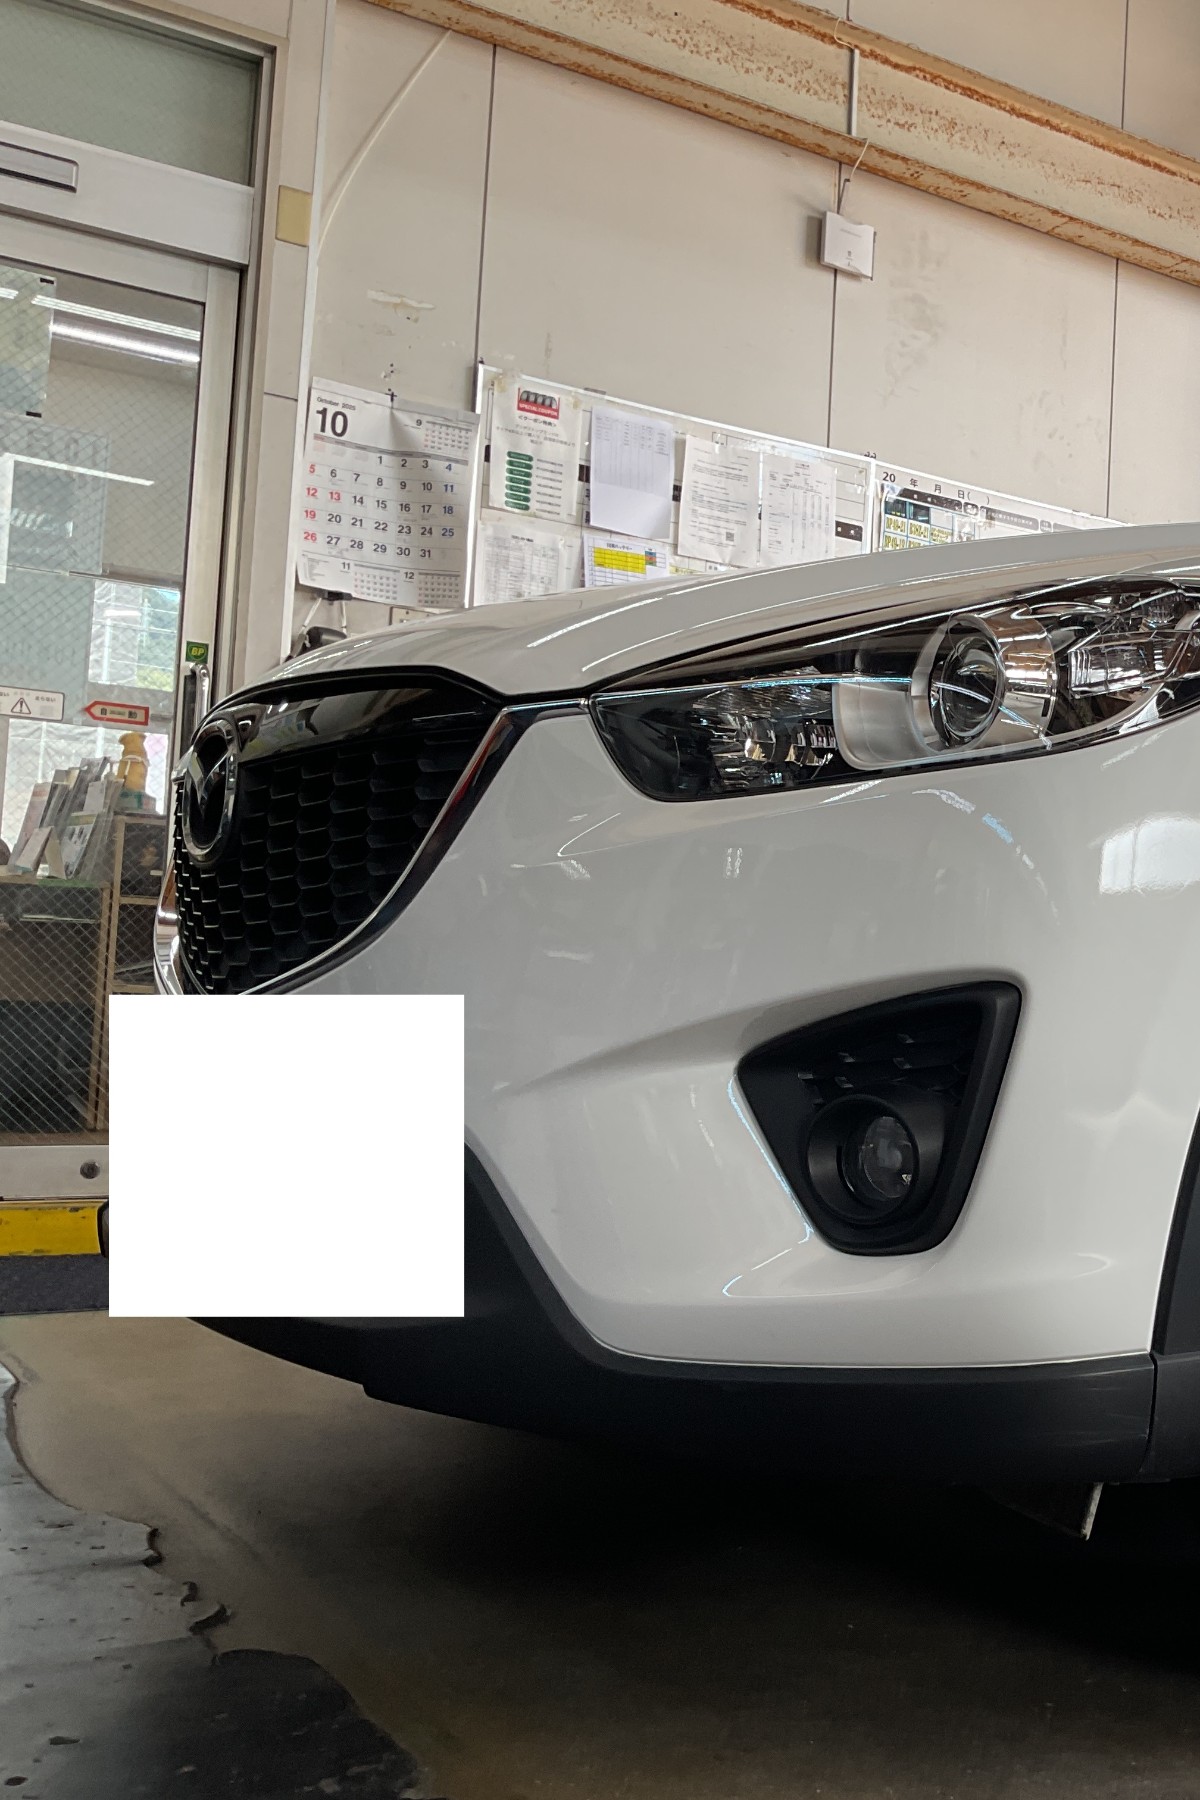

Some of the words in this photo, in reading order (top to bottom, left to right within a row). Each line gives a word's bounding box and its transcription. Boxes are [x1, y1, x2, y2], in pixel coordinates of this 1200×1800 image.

[341, 402, 356, 411] 2025
[316, 406, 348, 437] 10
[416, 418, 423, 427] 9
[377, 455, 383, 465] 1
[401, 458, 408, 468] 2
[422, 459, 429, 469] 3
[445, 463, 452, 471] 4
[309, 464, 316, 474] 5
[330, 468, 337, 478] 6
[353, 472, 360, 482] 7
[376, 477, 383, 487] 8
[400, 481, 407, 490] 9
[422, 482, 433, 491] 10
[443, 484, 454, 493] 11
[882, 471, 896, 483] 20
[909, 478, 919, 488] 年
[934, 483, 942, 494] 月
[306, 487, 318, 497] 12
[329, 491, 341, 501] 13
[352, 495, 364, 505] 14
[376, 499, 388, 509] 15
[399, 503, 411, 512] 16
[421, 504, 432, 513] 17
[442, 505, 454, 514] 18
[304, 509, 316, 519] 19
[327, 513, 342, 524] 20
[351, 517, 363, 527] 21
[374, 521, 388, 531] 22
[397, 524, 412, 534] 23
[420, 526, 433, 536] 24
[441, 527, 454, 537] 25
[303, 531, 317, 542] 26
[326, 535, 341, 546] 27
[350, 539, 364, 550] 28
[373, 543, 387, 553] 29
[396, 547, 411, 556] 30
[420, 548, 431, 558] 31
[341, 561, 351, 570] 11
[403, 571, 415, 580] 12
[191, 647, 205, 657] BP
